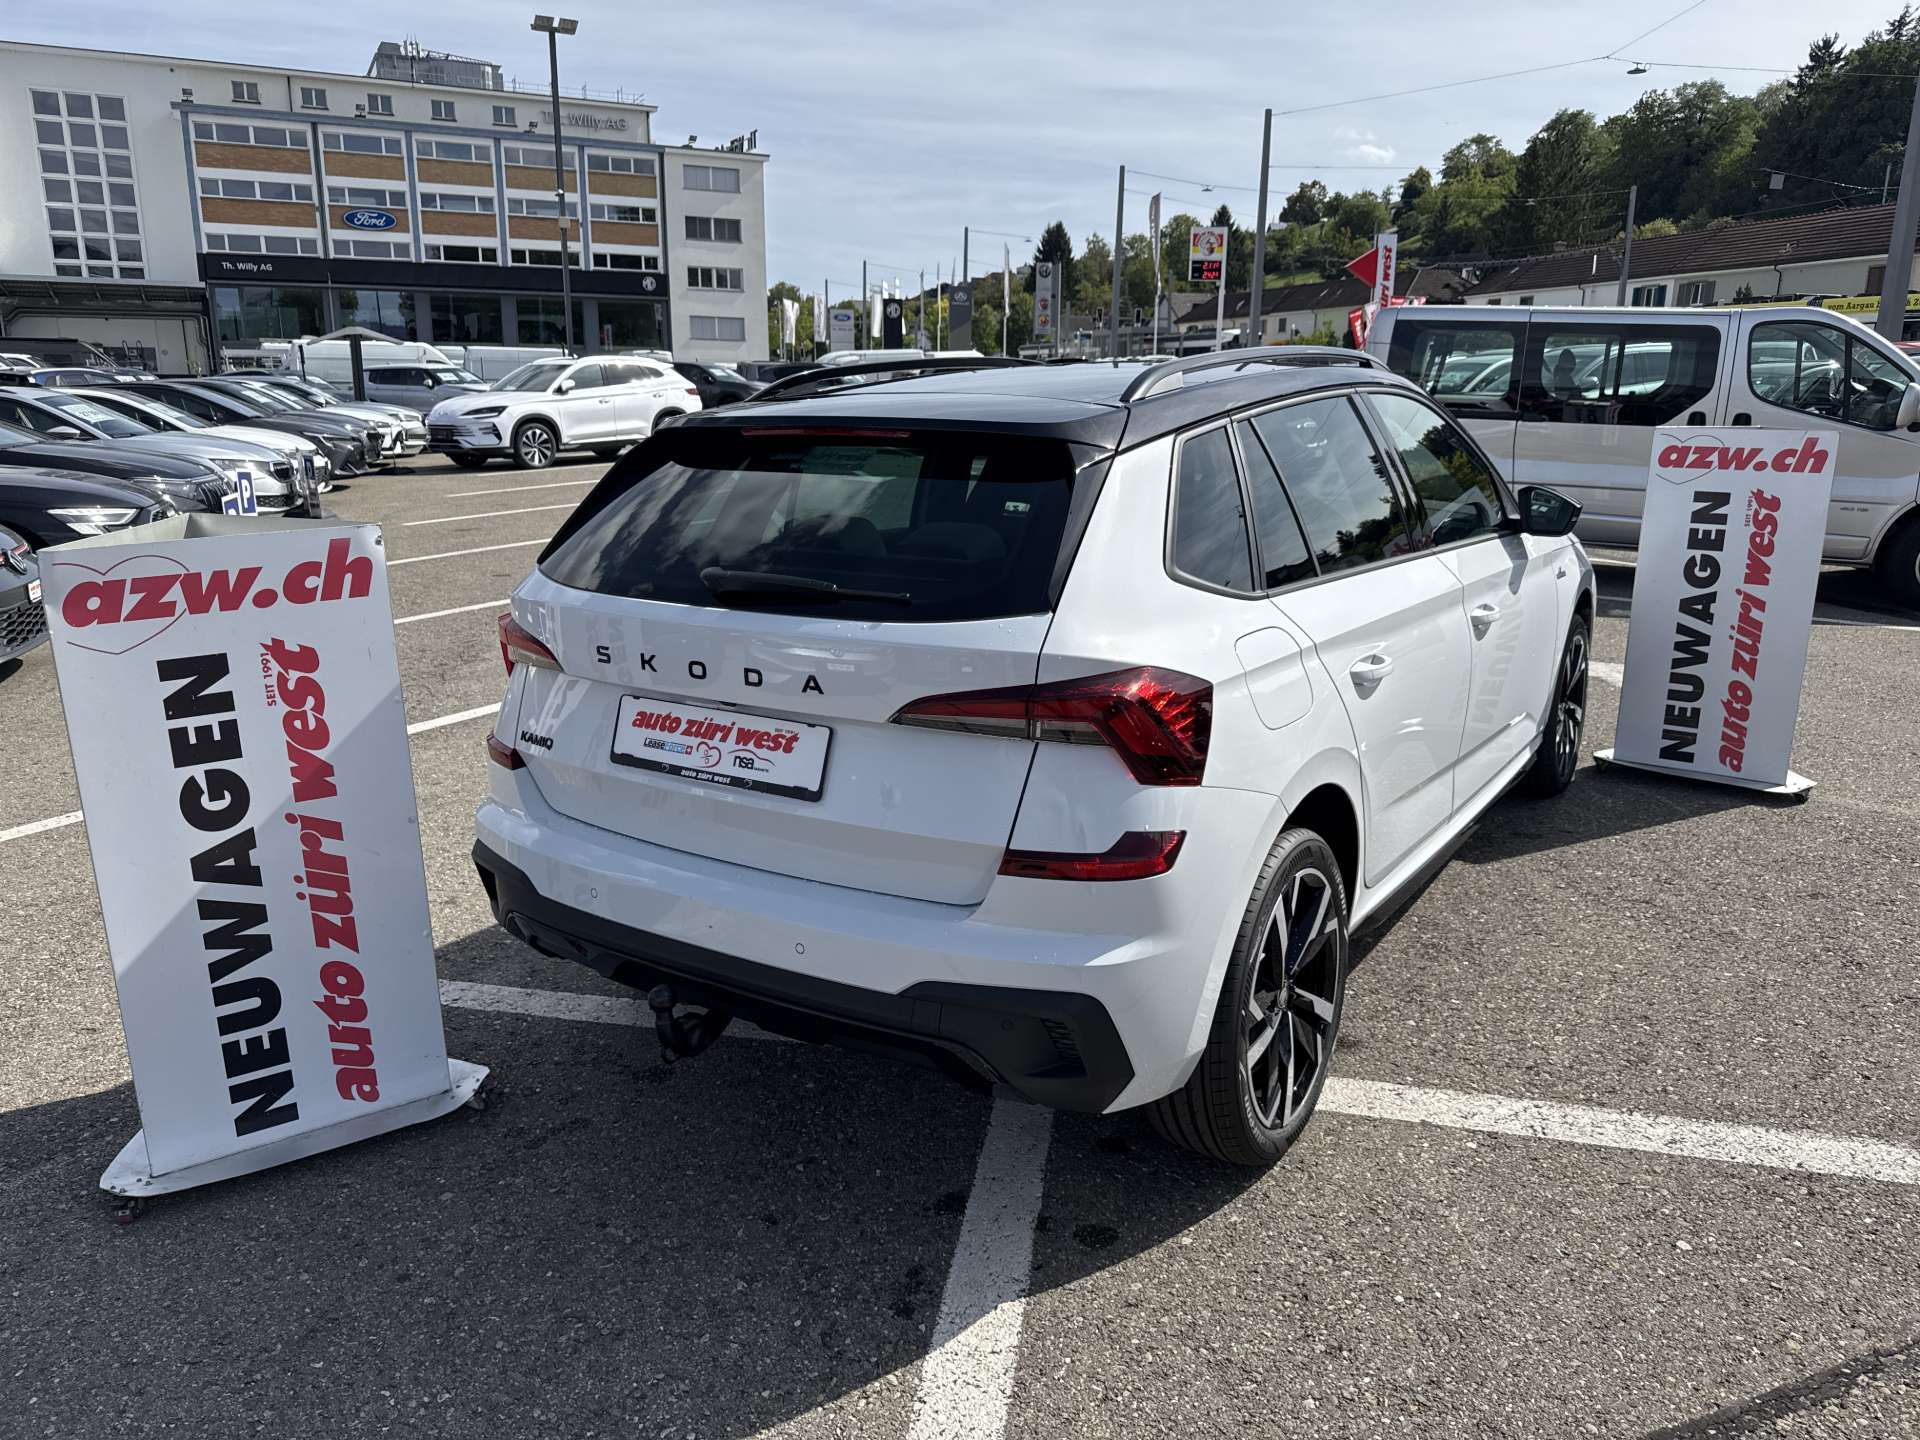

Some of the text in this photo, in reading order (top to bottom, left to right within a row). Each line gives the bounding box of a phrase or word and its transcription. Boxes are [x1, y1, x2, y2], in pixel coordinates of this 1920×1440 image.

[568, 112, 601, 131] Willy
[605, 118, 628, 131] AG
[353, 211, 387, 227] Ford
[221, 261, 273, 272] Th. Willy AG
[886, 302, 901, 319] MG
[1845, 301, 1875, 311] Aargau
[1657, 437, 1829, 474] azw.ch
[62, 538, 373, 628] azw.ch
[1659, 490, 1731, 763] NEUWAGEN
[1718, 488, 1781, 773] auto züri west
[260, 652, 277, 707] SEIT 1991
[596, 645, 824, 695] SKODA
[520, 730, 554, 751] KAMIQ
[631, 710, 799, 753] auto züri west
[680, 769, 732, 784] auto züri west
[733, 755, 755, 770] nsa
[261, 636, 380, 1103] auto züri west
[156, 651, 300, 1138] NEUWAGEN
